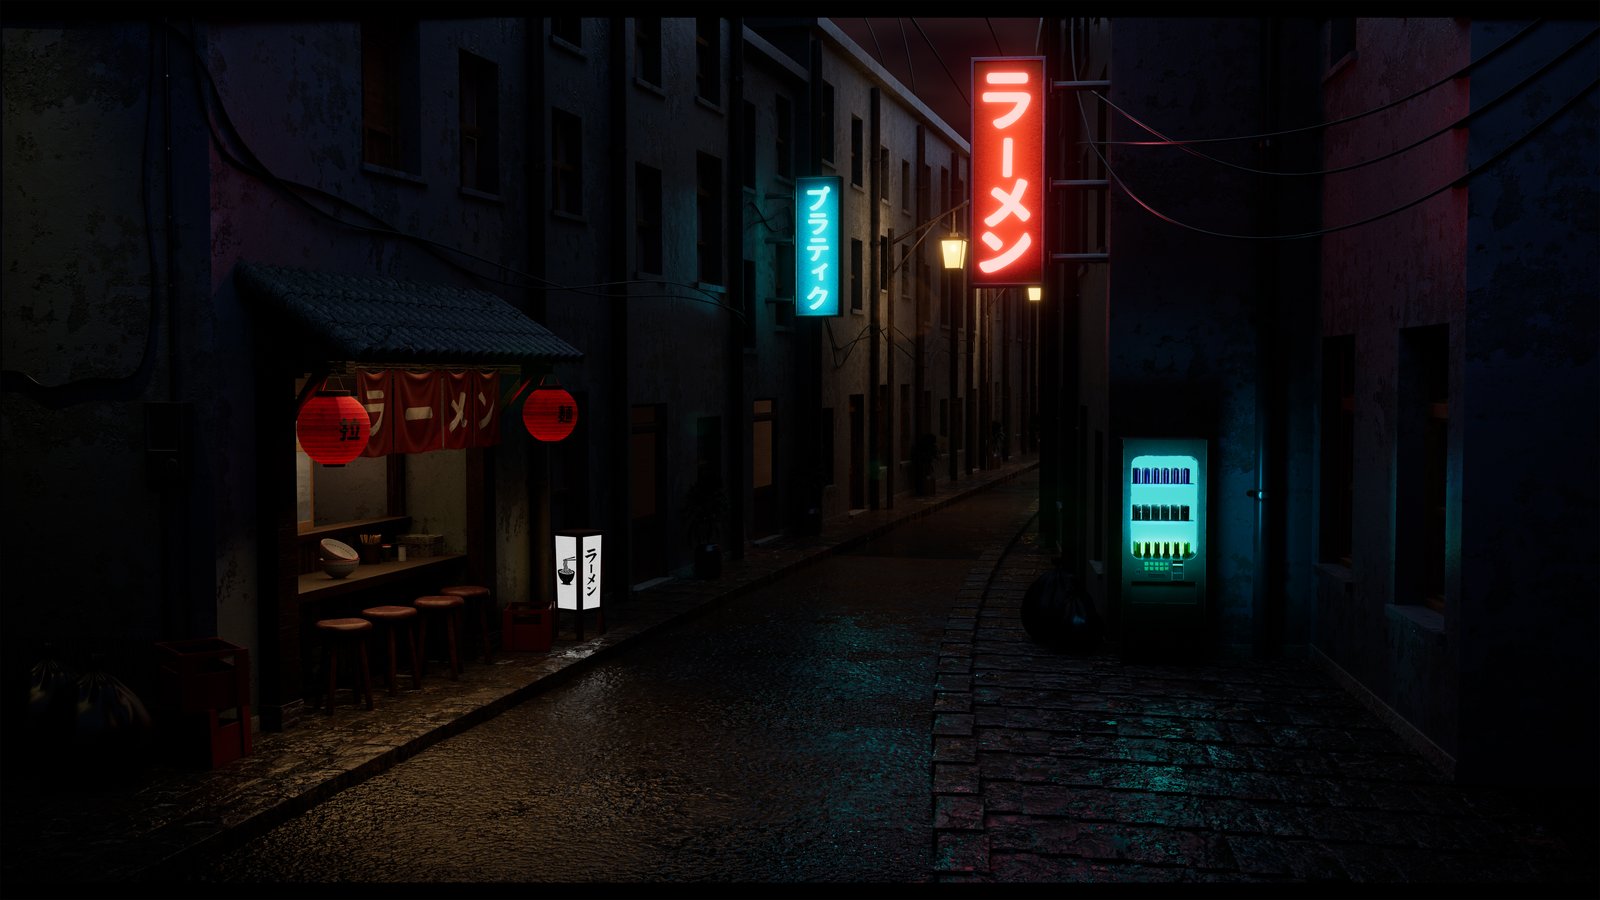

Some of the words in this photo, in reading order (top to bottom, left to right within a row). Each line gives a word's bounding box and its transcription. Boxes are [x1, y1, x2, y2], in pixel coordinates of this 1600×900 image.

[978, 71, 1032, 274] ラーメン
[806, 185, 831, 310] プラティク
[364, 389, 495, 437] ラーメン
[585, 548, 598, 597] ラーメン
